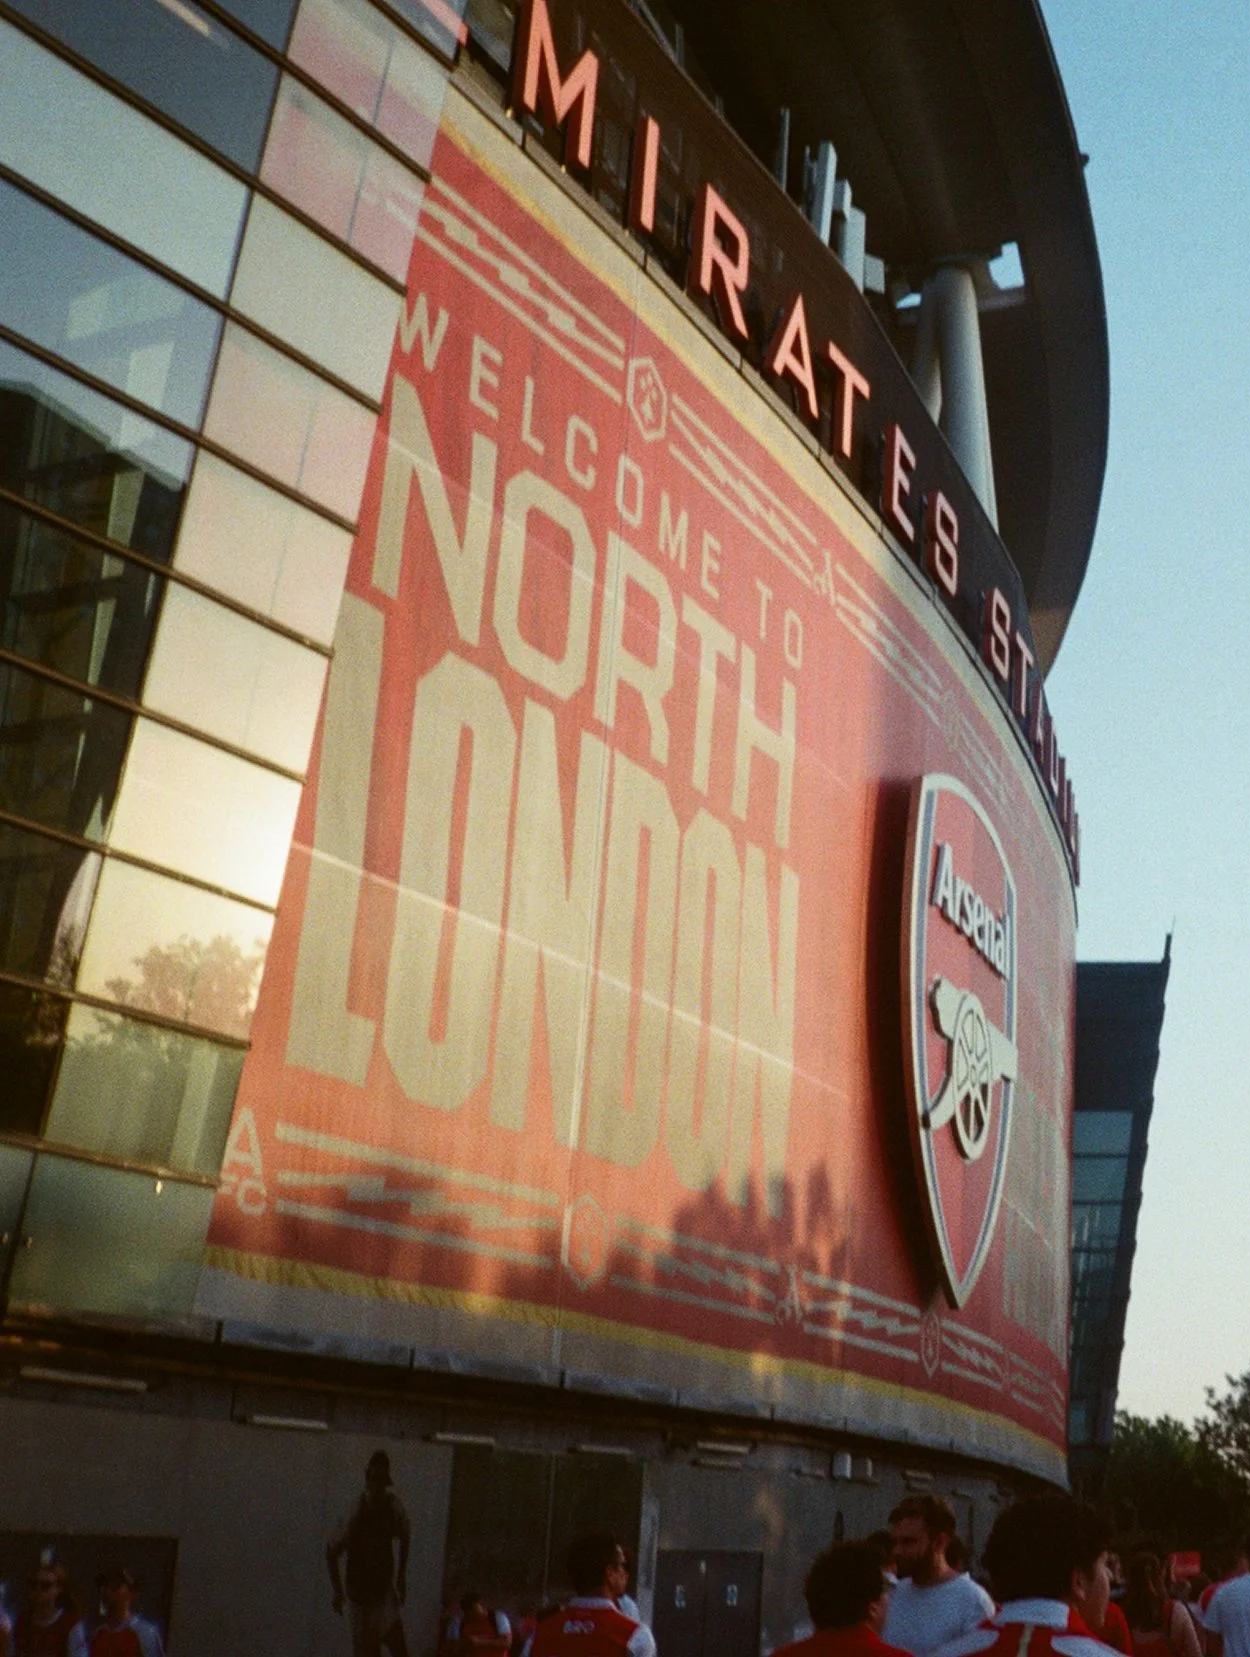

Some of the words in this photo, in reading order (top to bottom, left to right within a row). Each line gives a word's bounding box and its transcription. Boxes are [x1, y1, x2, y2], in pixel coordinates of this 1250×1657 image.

[399, 292, 721, 600] WELCOME
[756, 579, 803, 670] TO
[424, 0, 959, 597] MIRATES
[371, 372, 796, 850] NORTH
[285, 588, 800, 1222] LONDON
[933, 842, 1010, 979] Arsenal
